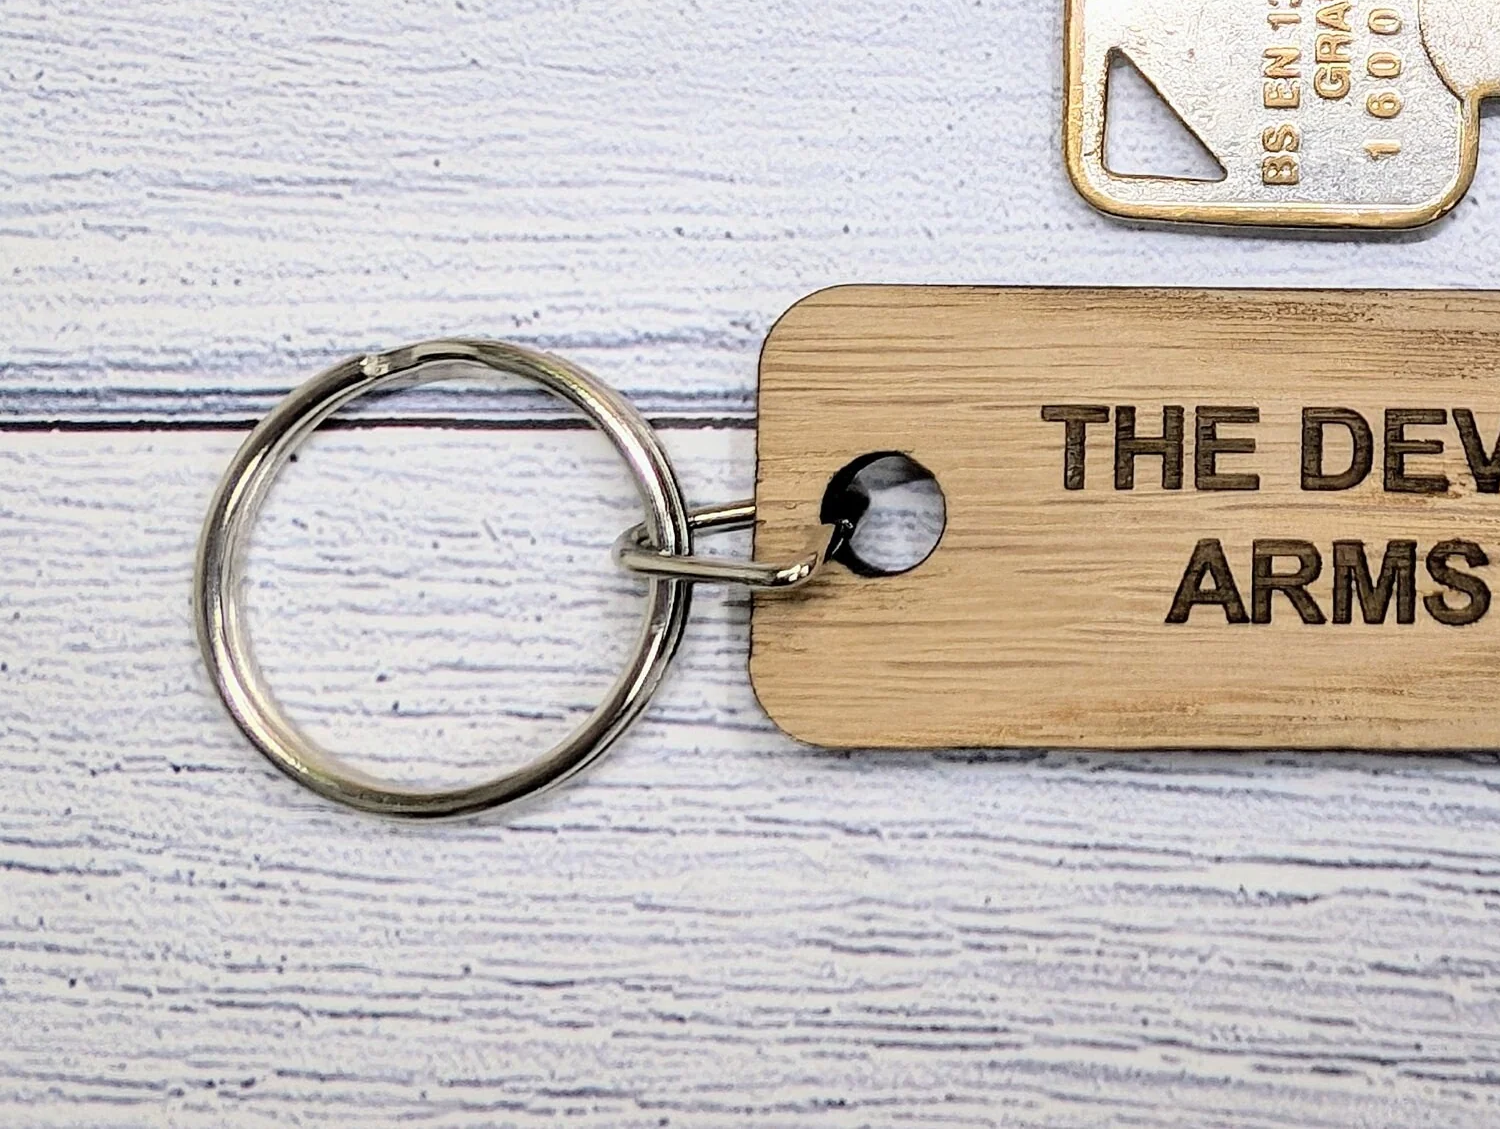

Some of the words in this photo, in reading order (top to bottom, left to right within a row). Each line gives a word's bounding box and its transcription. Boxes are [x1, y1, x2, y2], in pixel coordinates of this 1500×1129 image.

[1263, 48, 1301, 109] EN
[1262, 125, 1300, 185] BS
[1042, 406, 1260, 492] THE
[1166, 540, 1491, 626] ARMS
